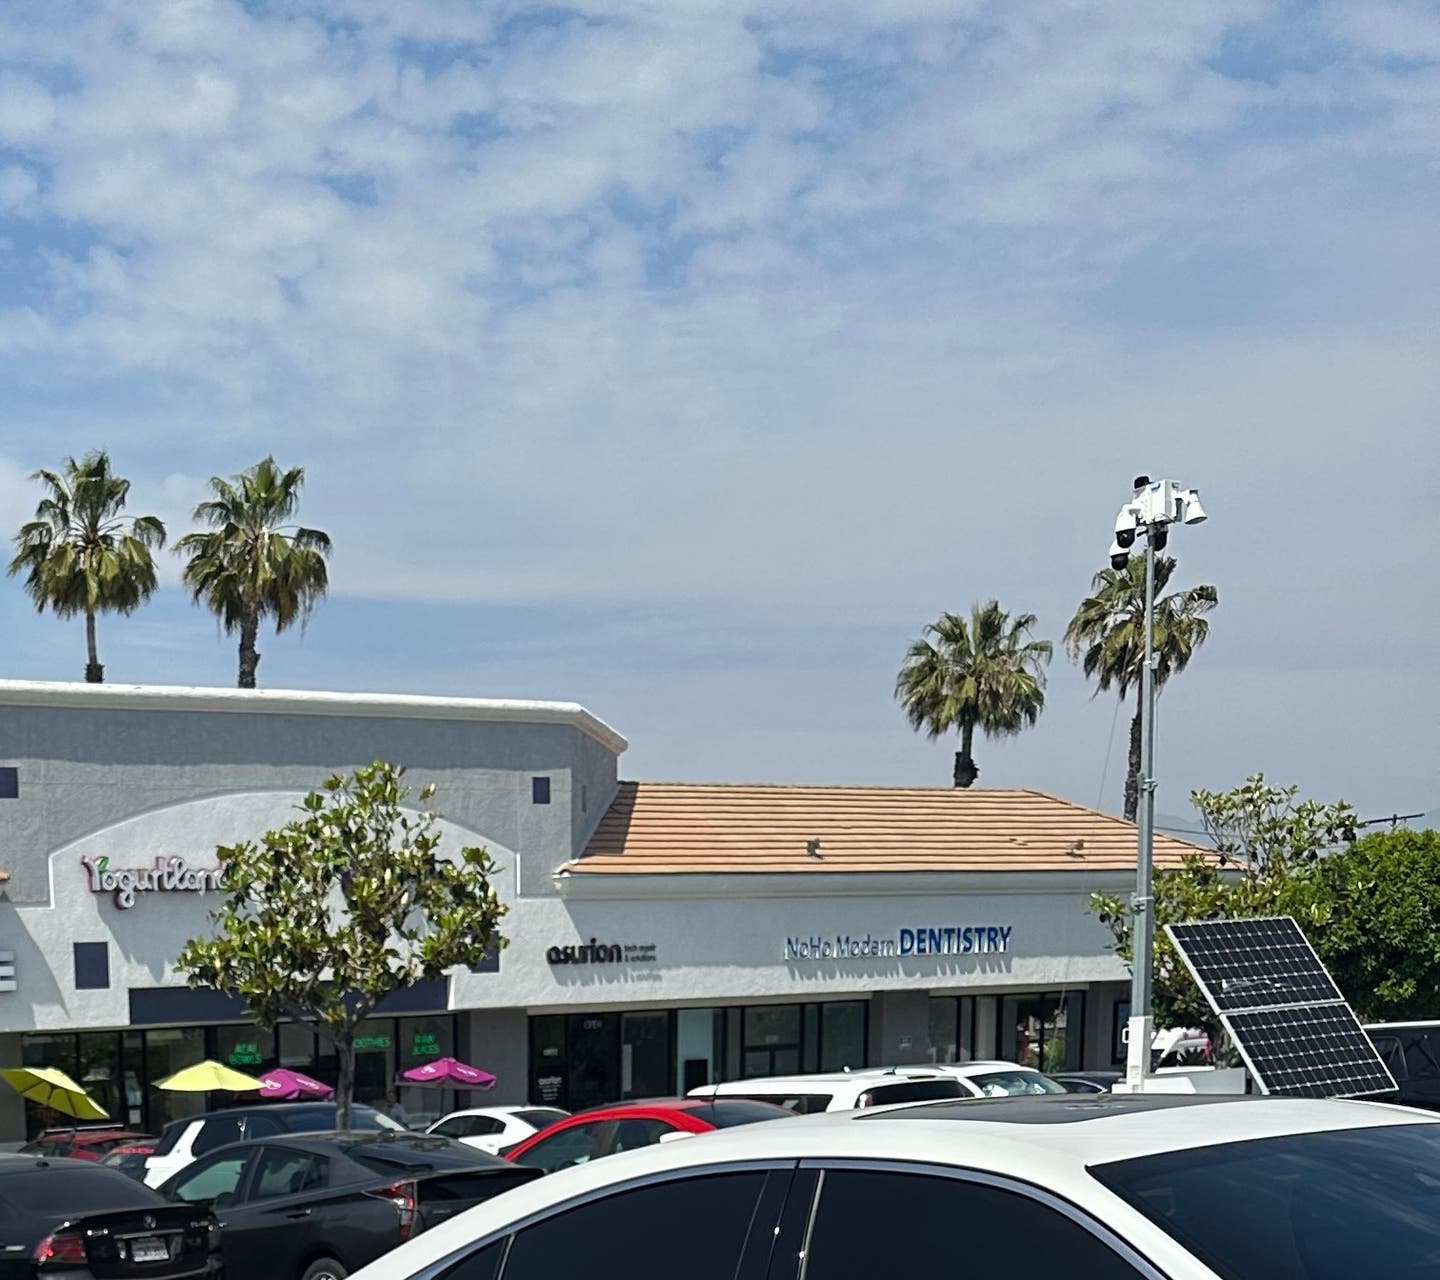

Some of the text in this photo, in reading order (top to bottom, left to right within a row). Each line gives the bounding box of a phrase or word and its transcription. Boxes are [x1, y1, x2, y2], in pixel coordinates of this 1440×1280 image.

[546, 937, 622, 965] asurion
[785, 936, 832, 959] NoHo
[897, 926, 1012, 956] DENTISTRY
